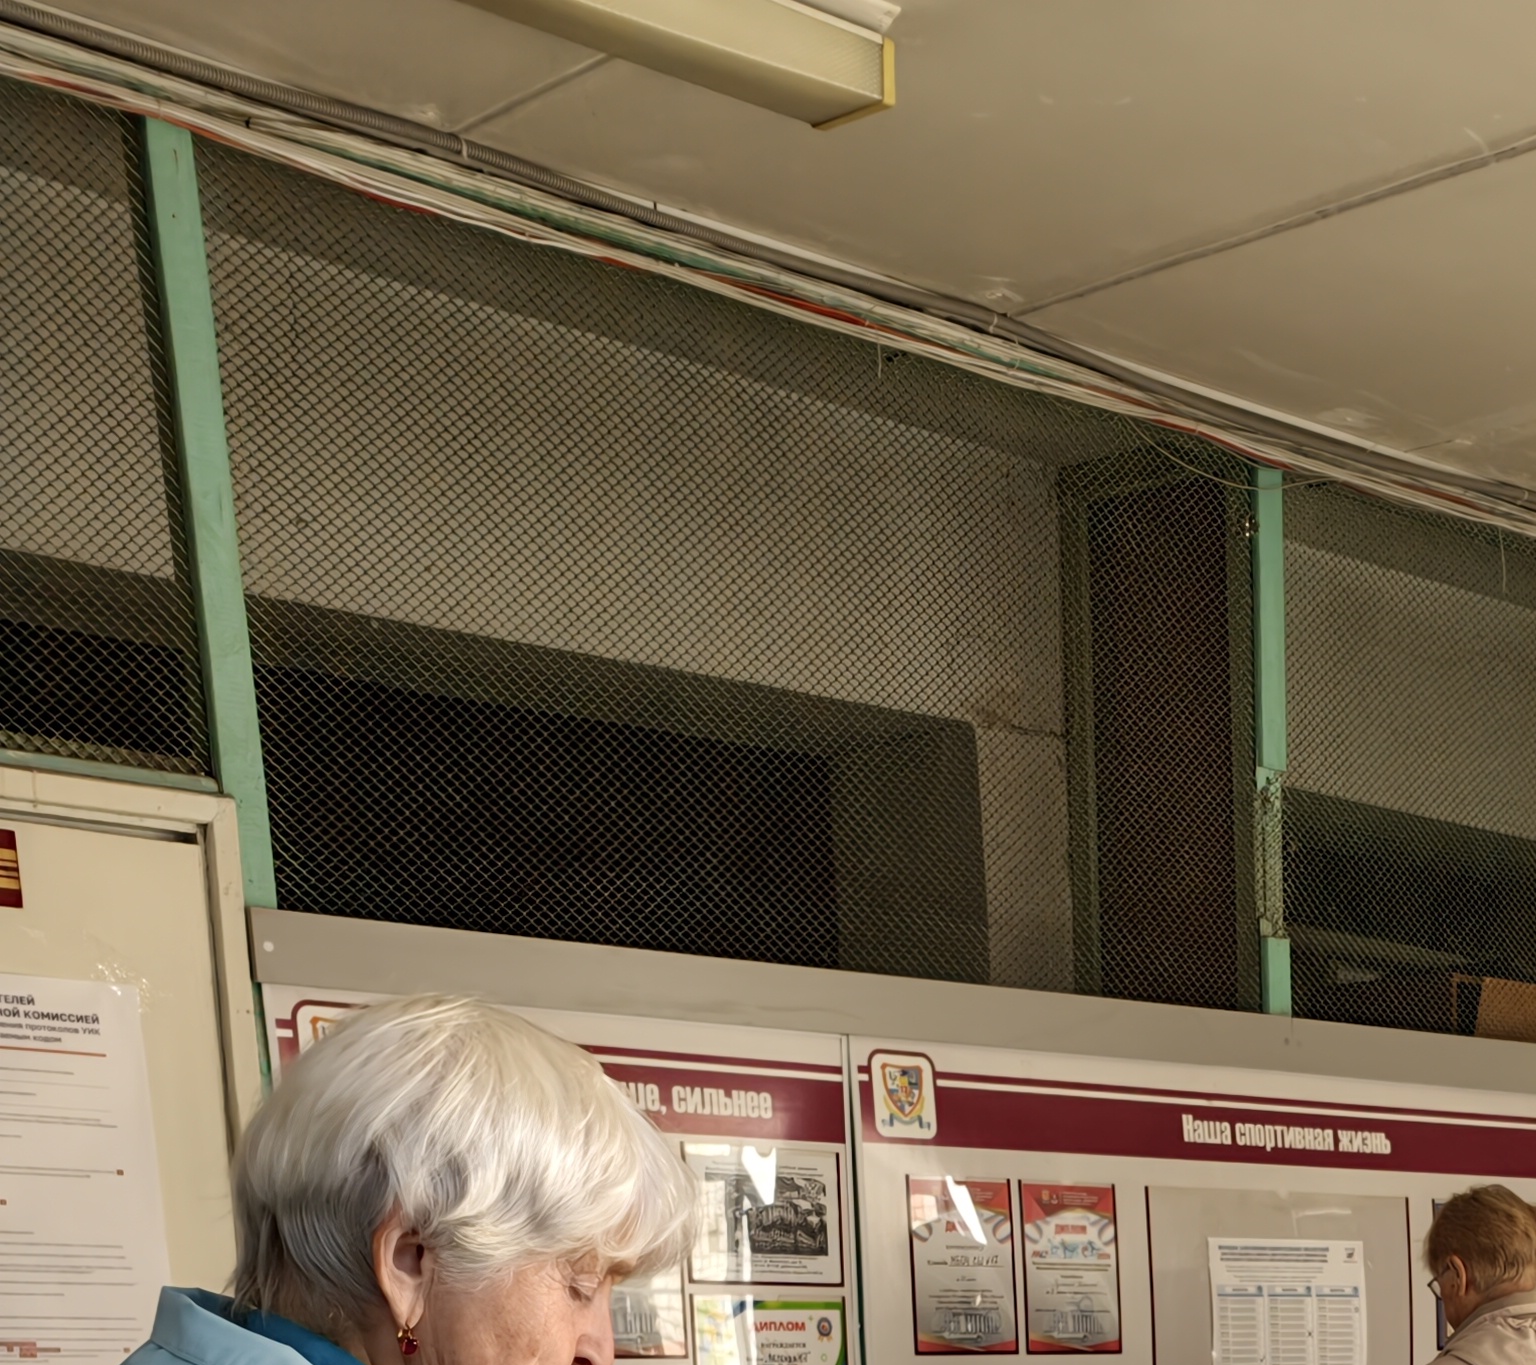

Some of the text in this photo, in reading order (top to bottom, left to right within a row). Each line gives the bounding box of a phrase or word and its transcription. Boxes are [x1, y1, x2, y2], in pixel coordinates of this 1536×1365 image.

[23, 1010, 100, 1024] КОМИССИЕЙ
[672, 1085, 773, 1119] сильнее
[1182, 1114, 1391, 1154] Наша спортивная жизнь
